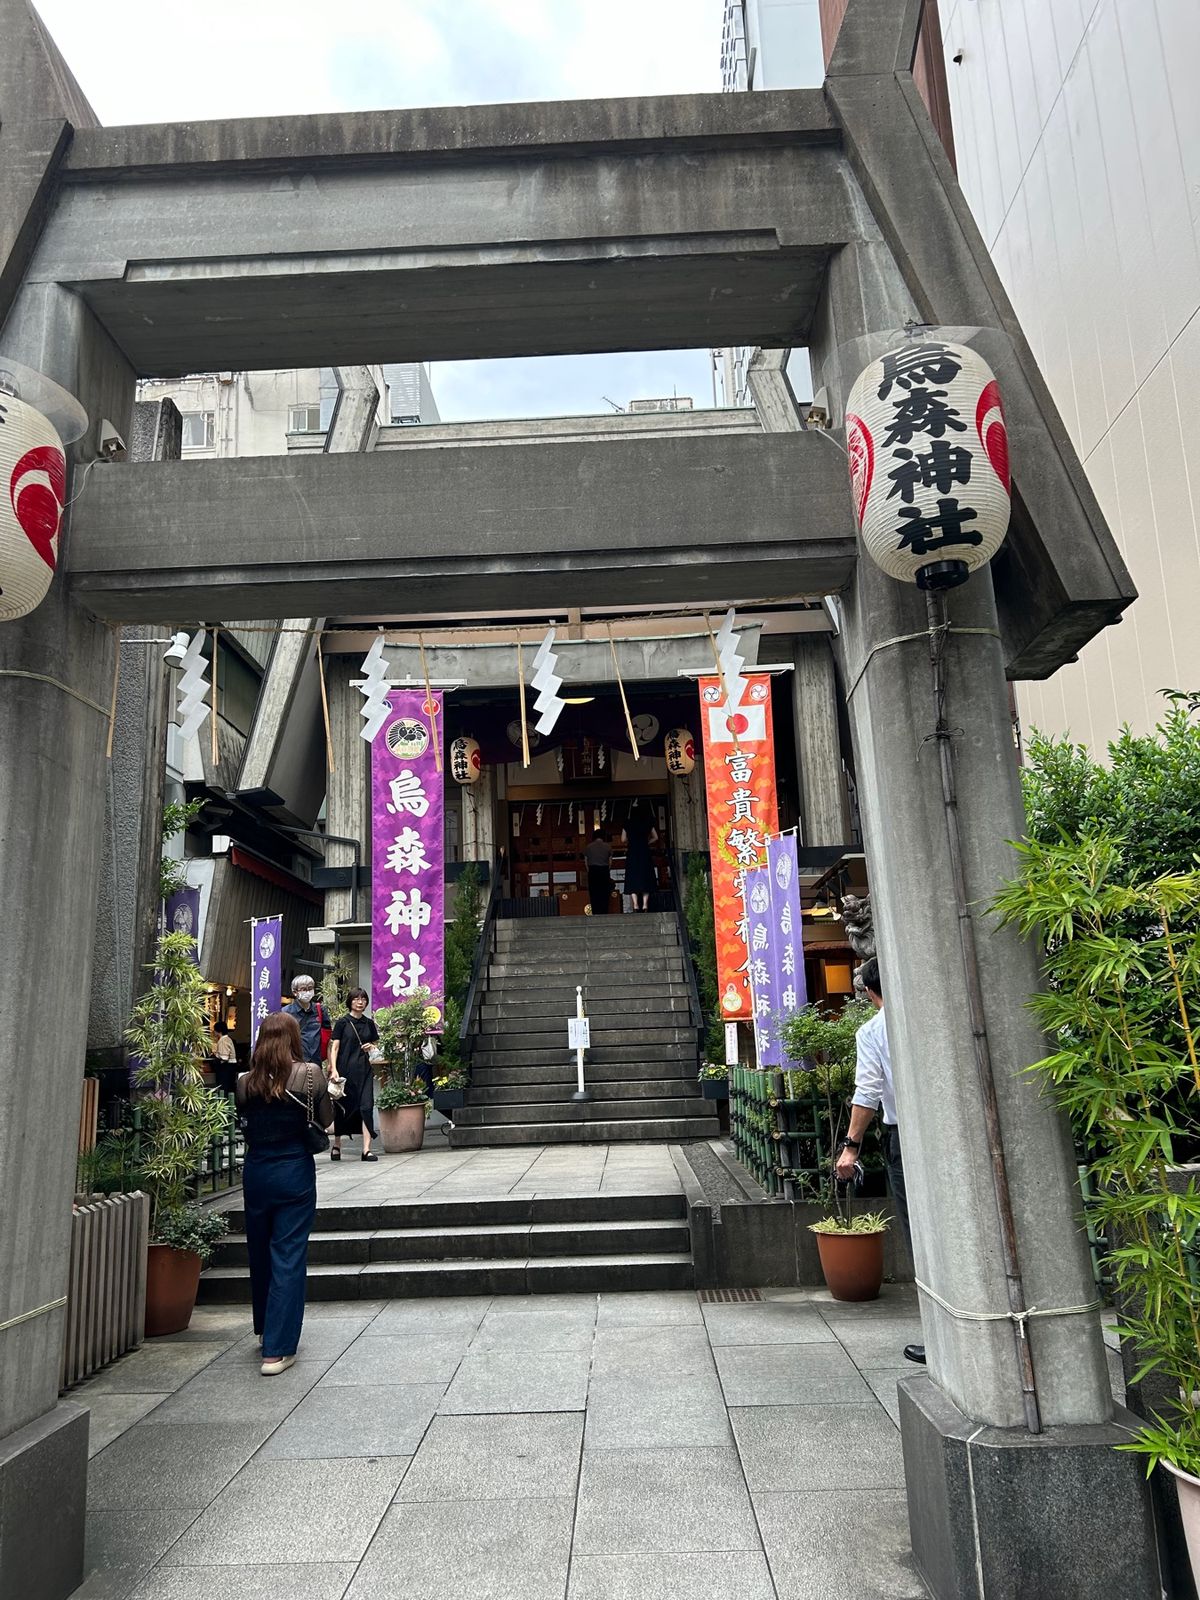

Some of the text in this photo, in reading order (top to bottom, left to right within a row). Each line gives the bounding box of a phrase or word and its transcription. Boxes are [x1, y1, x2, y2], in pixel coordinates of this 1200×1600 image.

[877, 342, 983, 554] 烏森神社
[453, 739, 471, 780] 烏森神社
[667, 730, 685, 770] 烏森神社
[384, 769, 433, 997] 烏森神社
